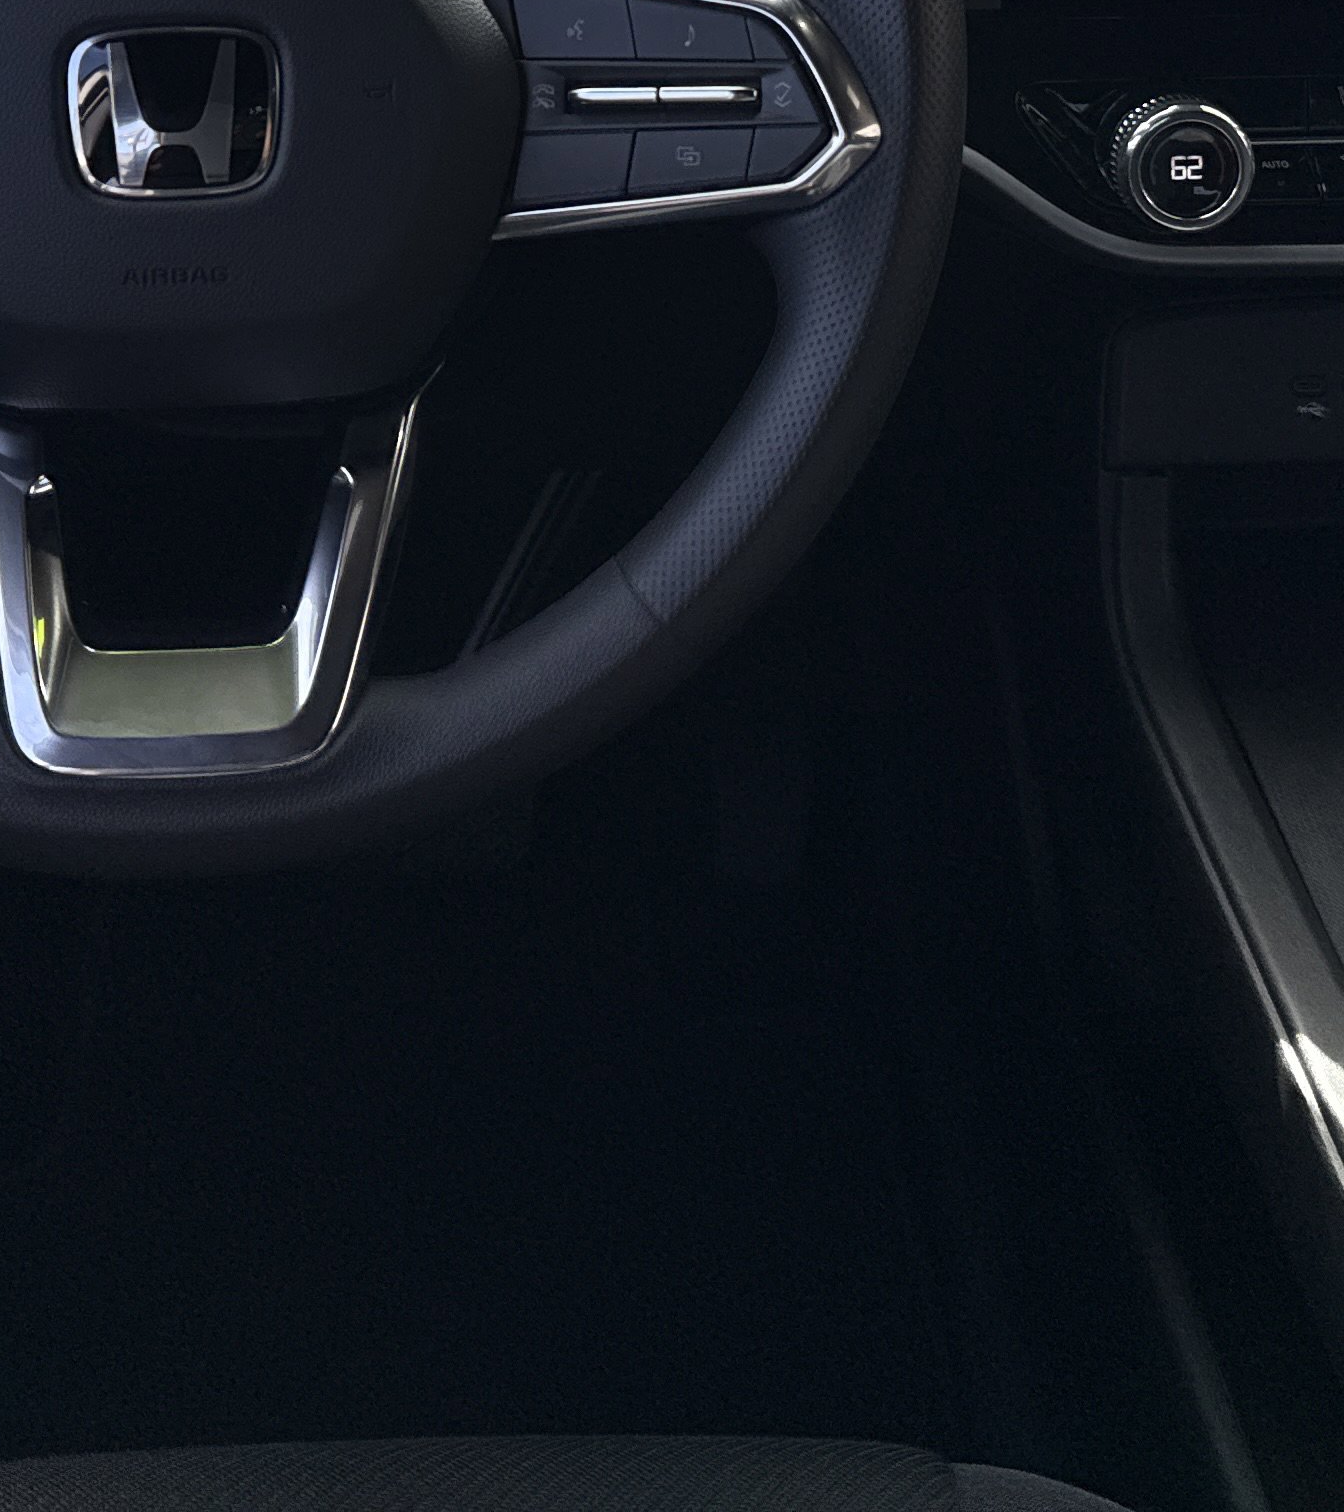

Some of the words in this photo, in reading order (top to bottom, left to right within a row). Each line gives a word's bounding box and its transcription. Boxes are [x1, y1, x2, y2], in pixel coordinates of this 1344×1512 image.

[1170, 155, 1203, 180] 62
[1261, 160, 1290, 169] AUTO
[121, 266, 229, 286] AIRBAG
